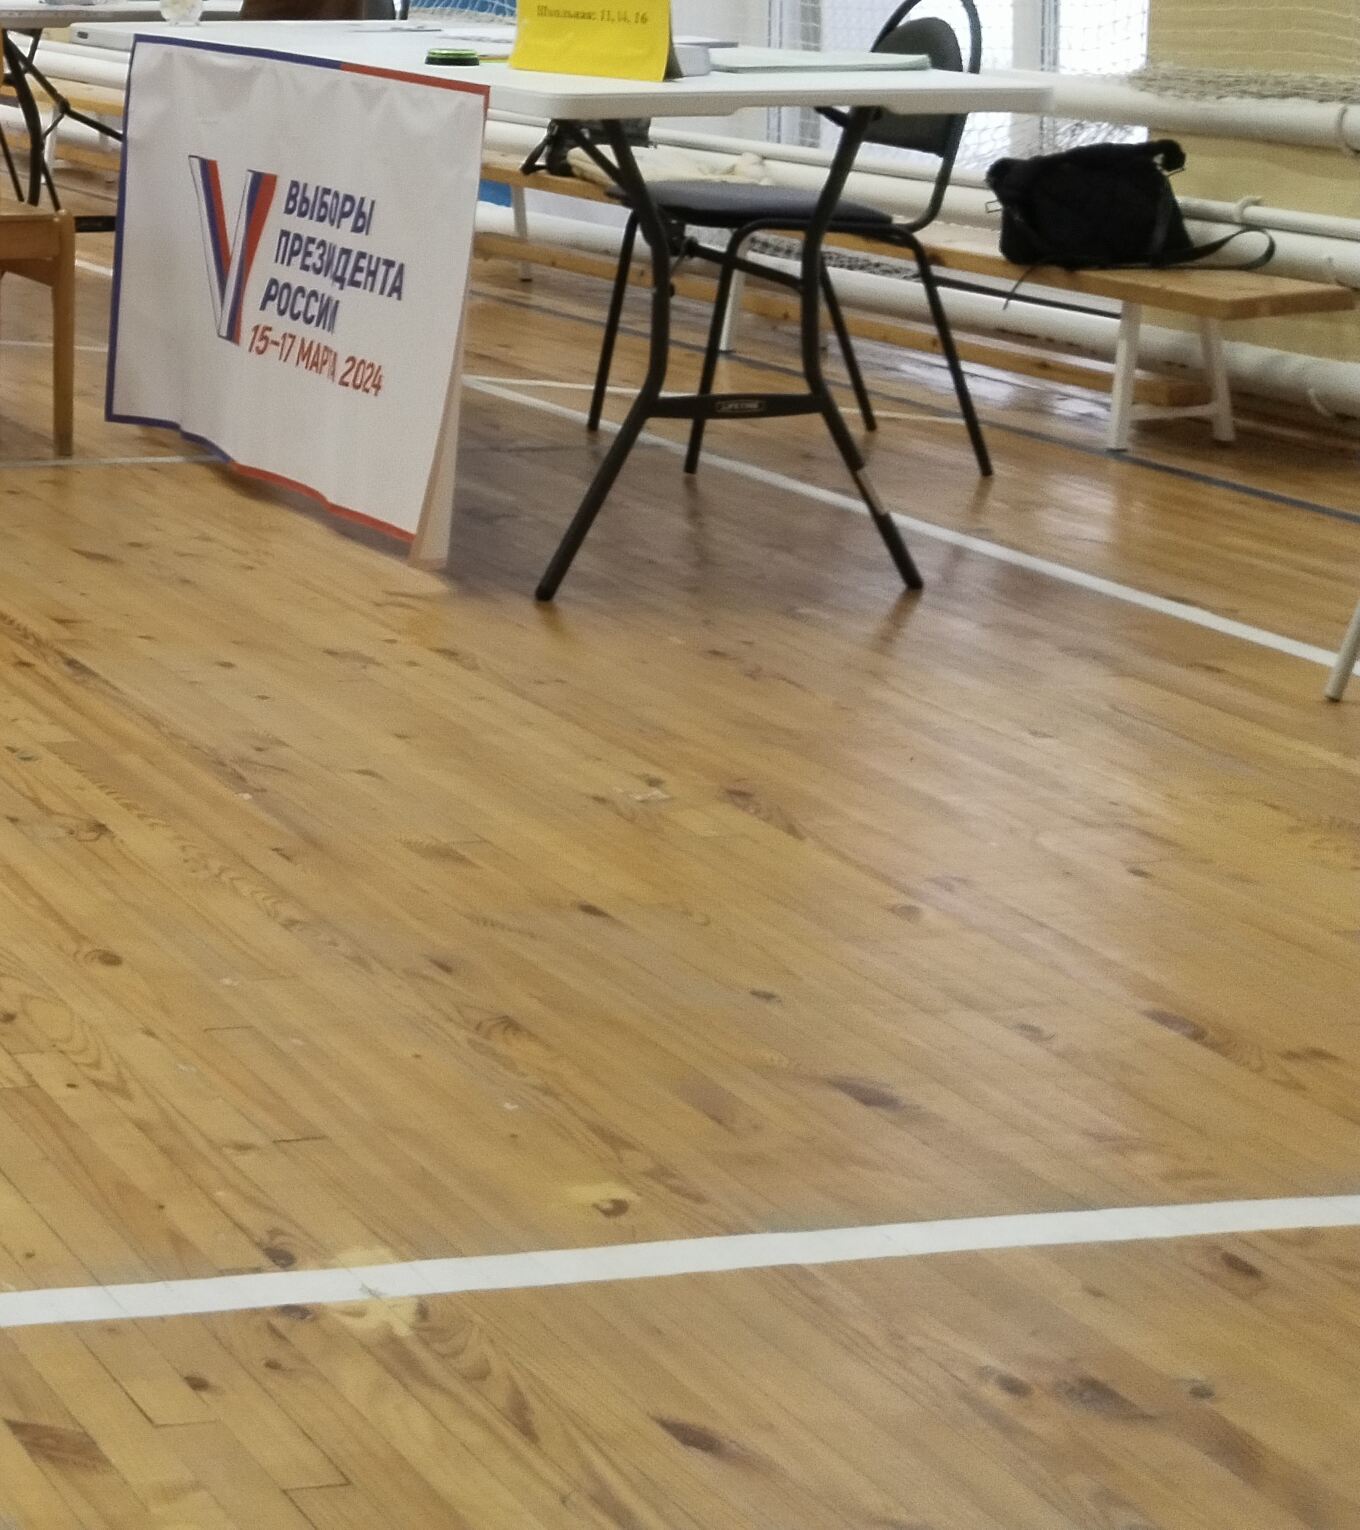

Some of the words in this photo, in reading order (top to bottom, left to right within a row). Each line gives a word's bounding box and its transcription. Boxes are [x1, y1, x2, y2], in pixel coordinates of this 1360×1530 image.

[283, 179, 375, 236] ВЫБОРЫ
[274, 228, 405, 301] ПРЕЗИДЕНТА
[259, 277, 340, 334] РОССИИ
[338, 355, 384, 398] 2024
